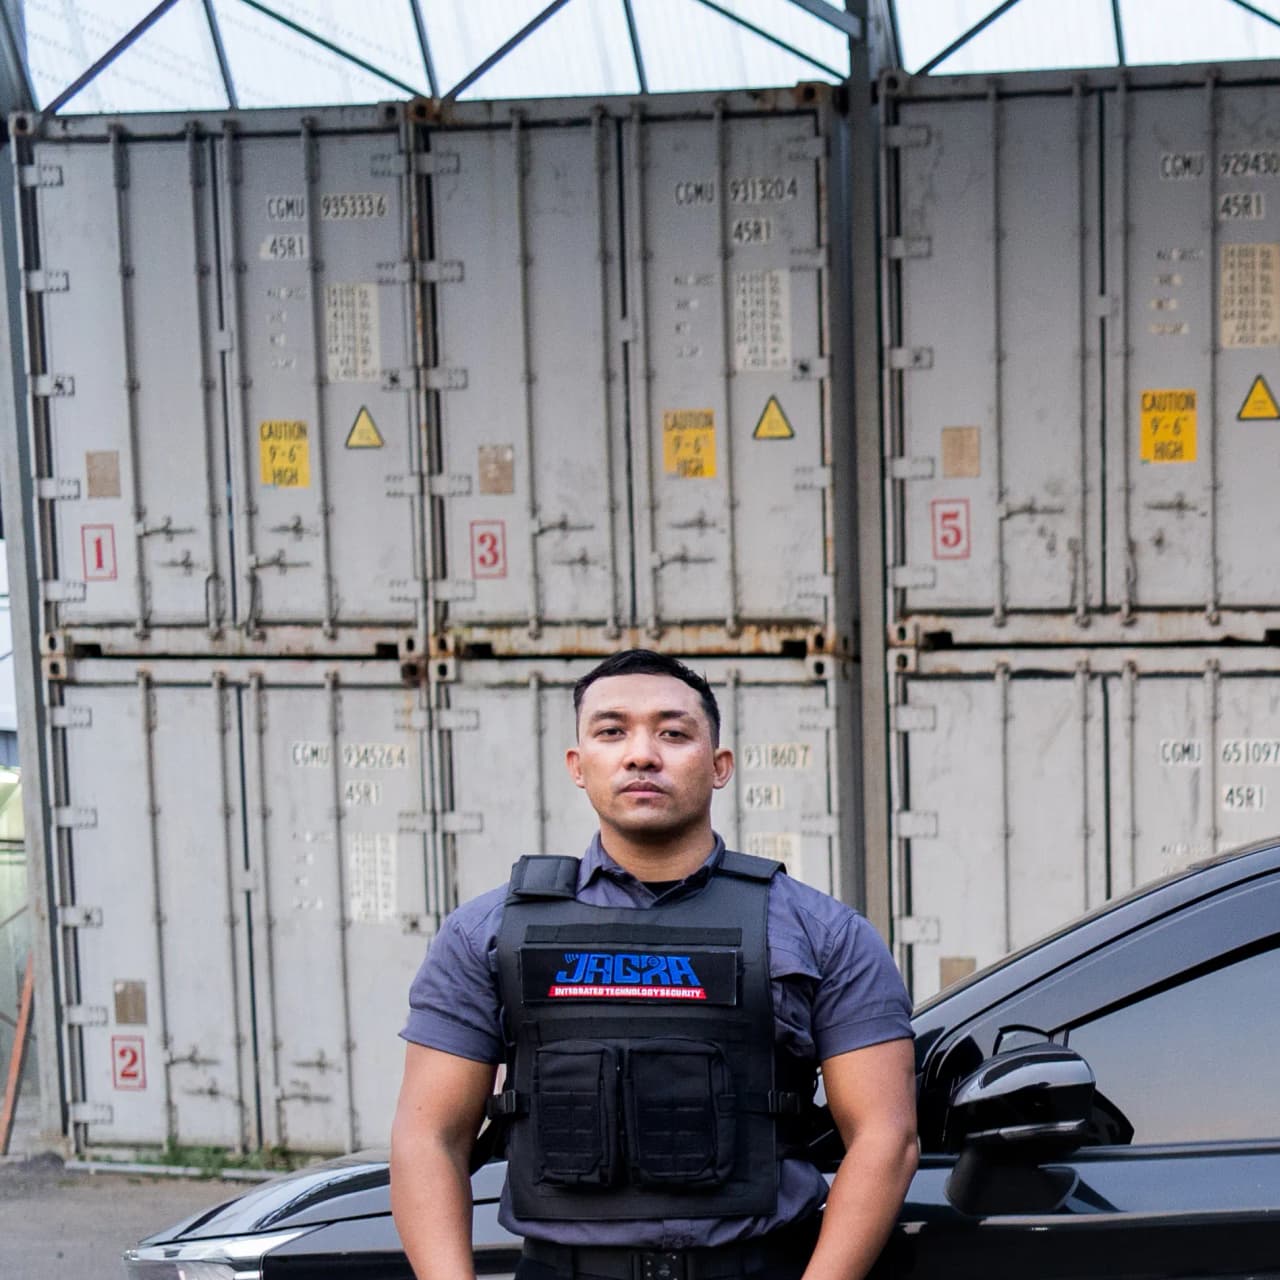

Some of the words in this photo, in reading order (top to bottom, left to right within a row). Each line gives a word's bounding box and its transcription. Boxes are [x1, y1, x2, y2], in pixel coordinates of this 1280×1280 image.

[941, 511, 962, 548] 5
[94, 537, 104, 569] 1
[478, 532, 499, 567] 3
[555, 986, 604, 997] INTEGRATED
[605, 987, 659, 998] TECHNOLOGY
[659, 988, 701, 998] SECURITY
[118, 1047, 138, 1079] 2
